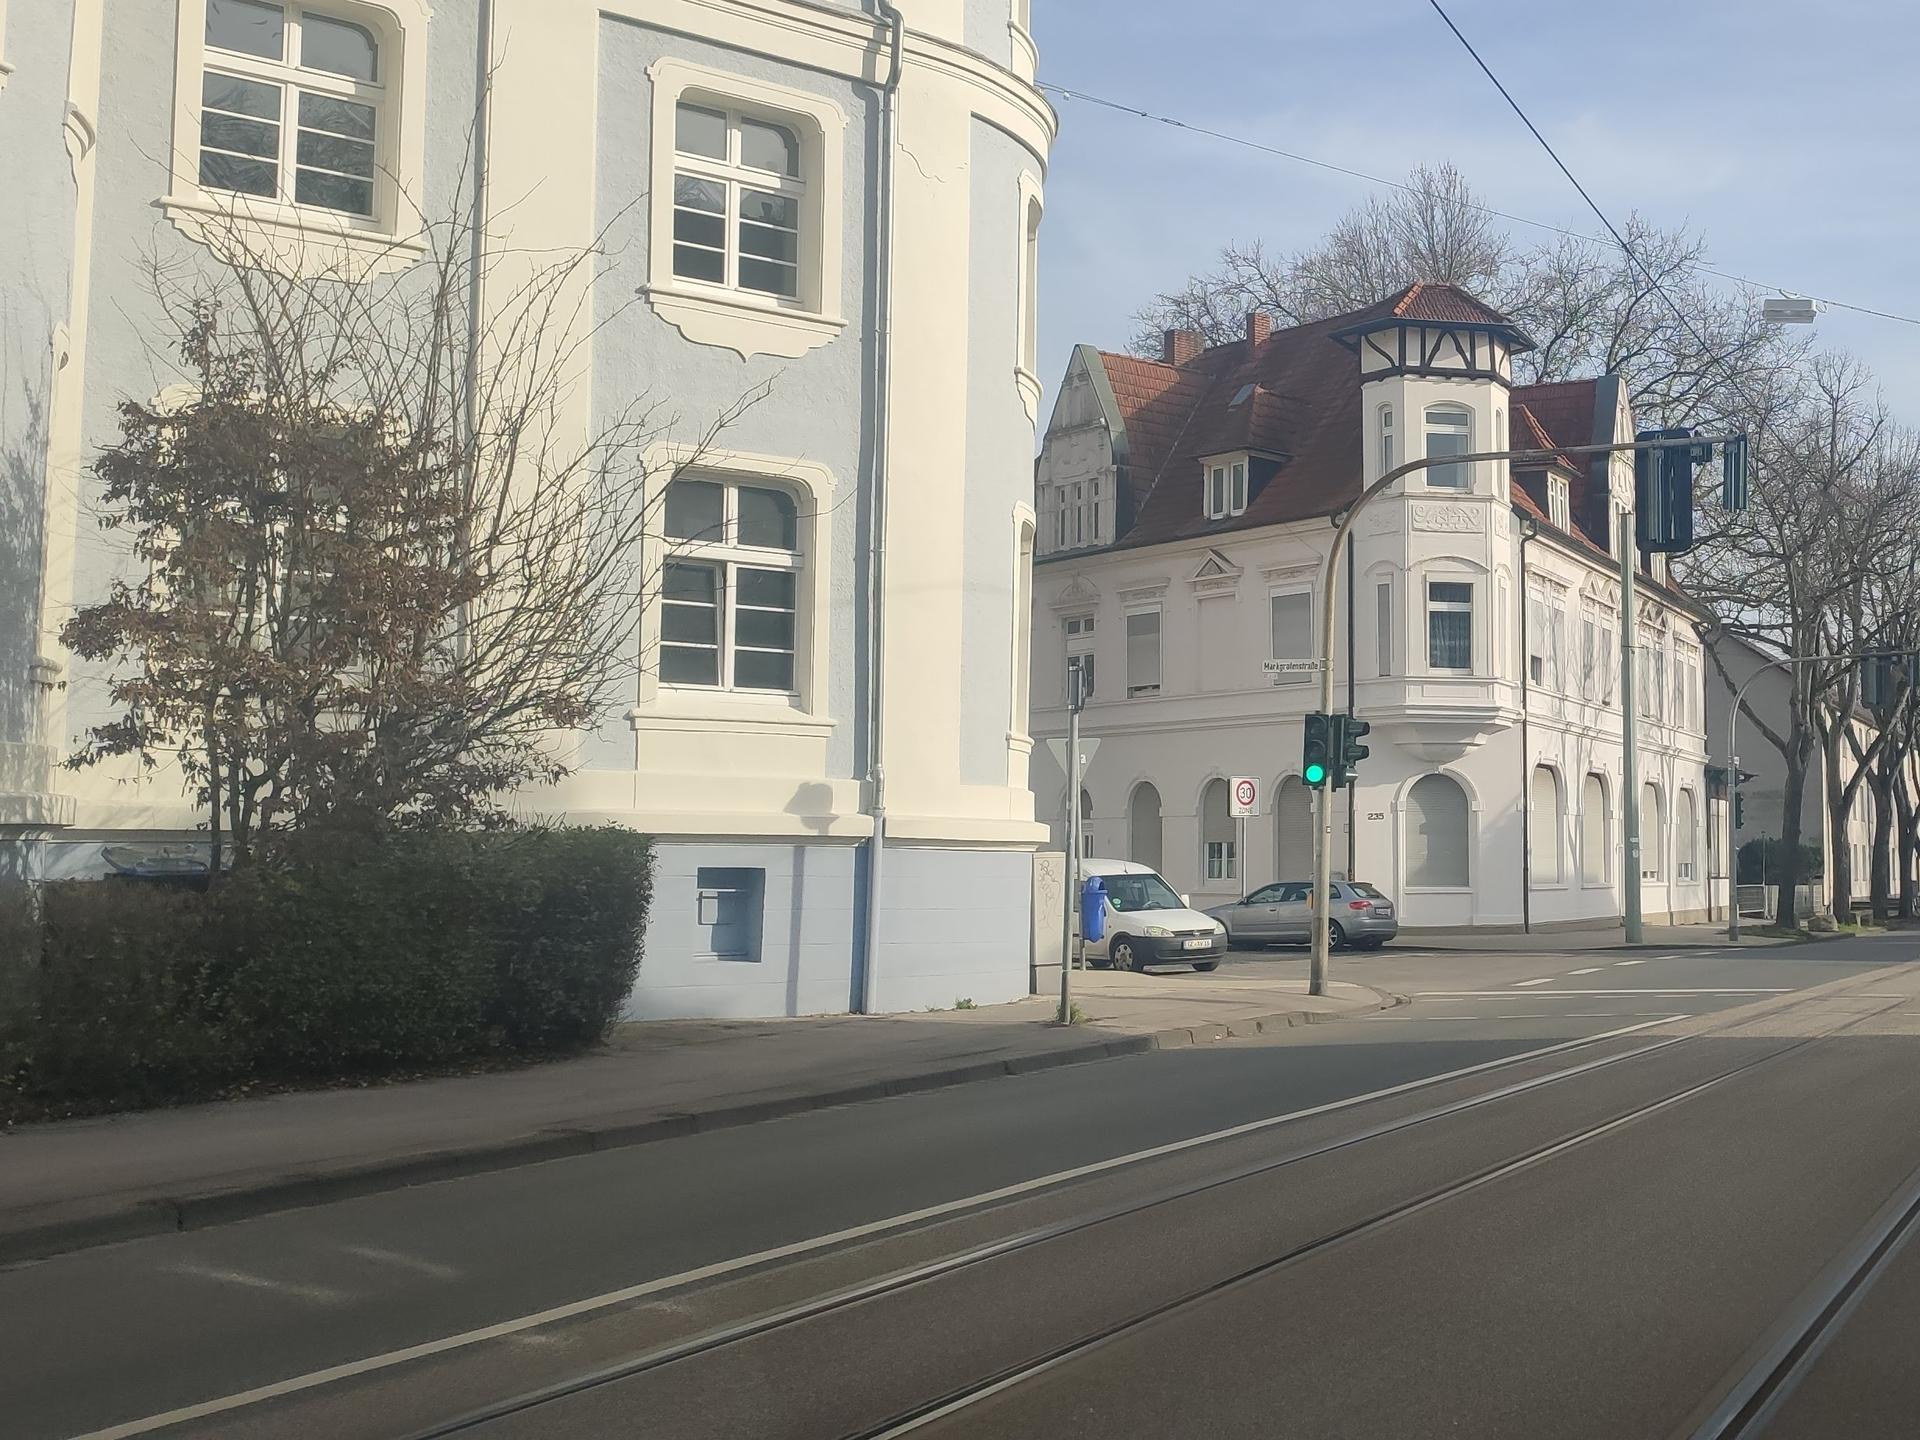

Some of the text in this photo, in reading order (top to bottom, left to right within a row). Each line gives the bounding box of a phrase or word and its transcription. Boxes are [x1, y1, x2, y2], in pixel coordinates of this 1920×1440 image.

[1264, 661, 1318, 672] Markgrafenstraße
[1240, 787, 1252, 799] 30
[1367, 812, 1385, 821] 235
